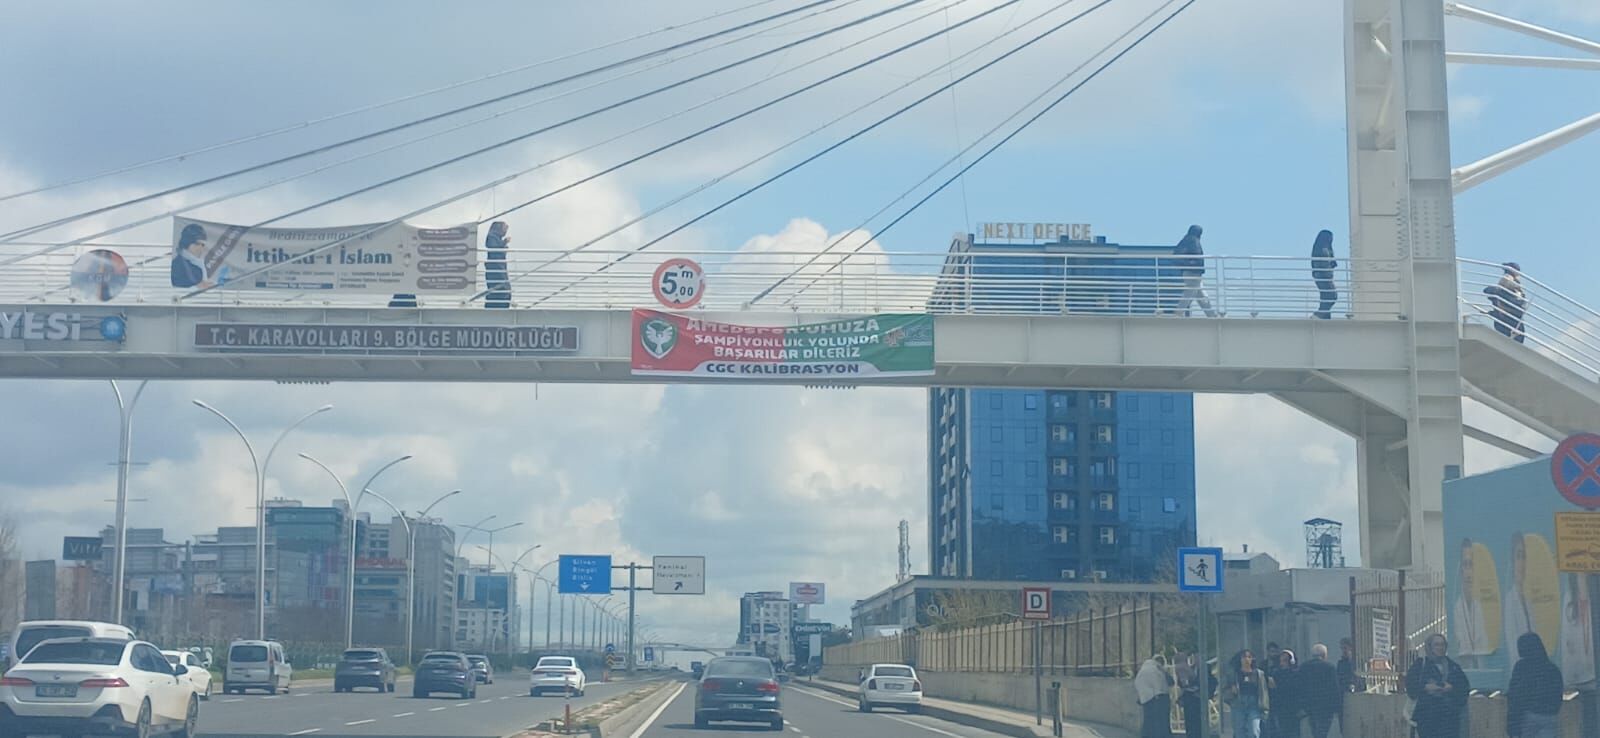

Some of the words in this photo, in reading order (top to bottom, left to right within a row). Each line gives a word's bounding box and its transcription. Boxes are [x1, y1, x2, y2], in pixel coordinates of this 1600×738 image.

[984, 223, 1025, 239] NEXT
[1033, 223, 1091, 240] OFFICE
[339, 244, 393, 265] İslam
[210, 327, 242, 345] T.C.
[249, 328, 368, 346] KARAYOLLARI
[374, 329, 389, 347] 9.
[395, 327, 450, 348] BÖLGE
[456, 327, 564, 348] MÜDÜRLÜĞÜ
[694, 334, 803, 347] ŞAMPİYONLUK
[808, 334, 880, 347] YOLUNDA
[714, 346, 799, 360] BAŞARILAR
[803, 346, 861, 359] DİLERİZ
[706, 363, 736, 374] CGC
[740, 362, 859, 374] KALİBRASYON
[1030, 594, 1043, 609] D
